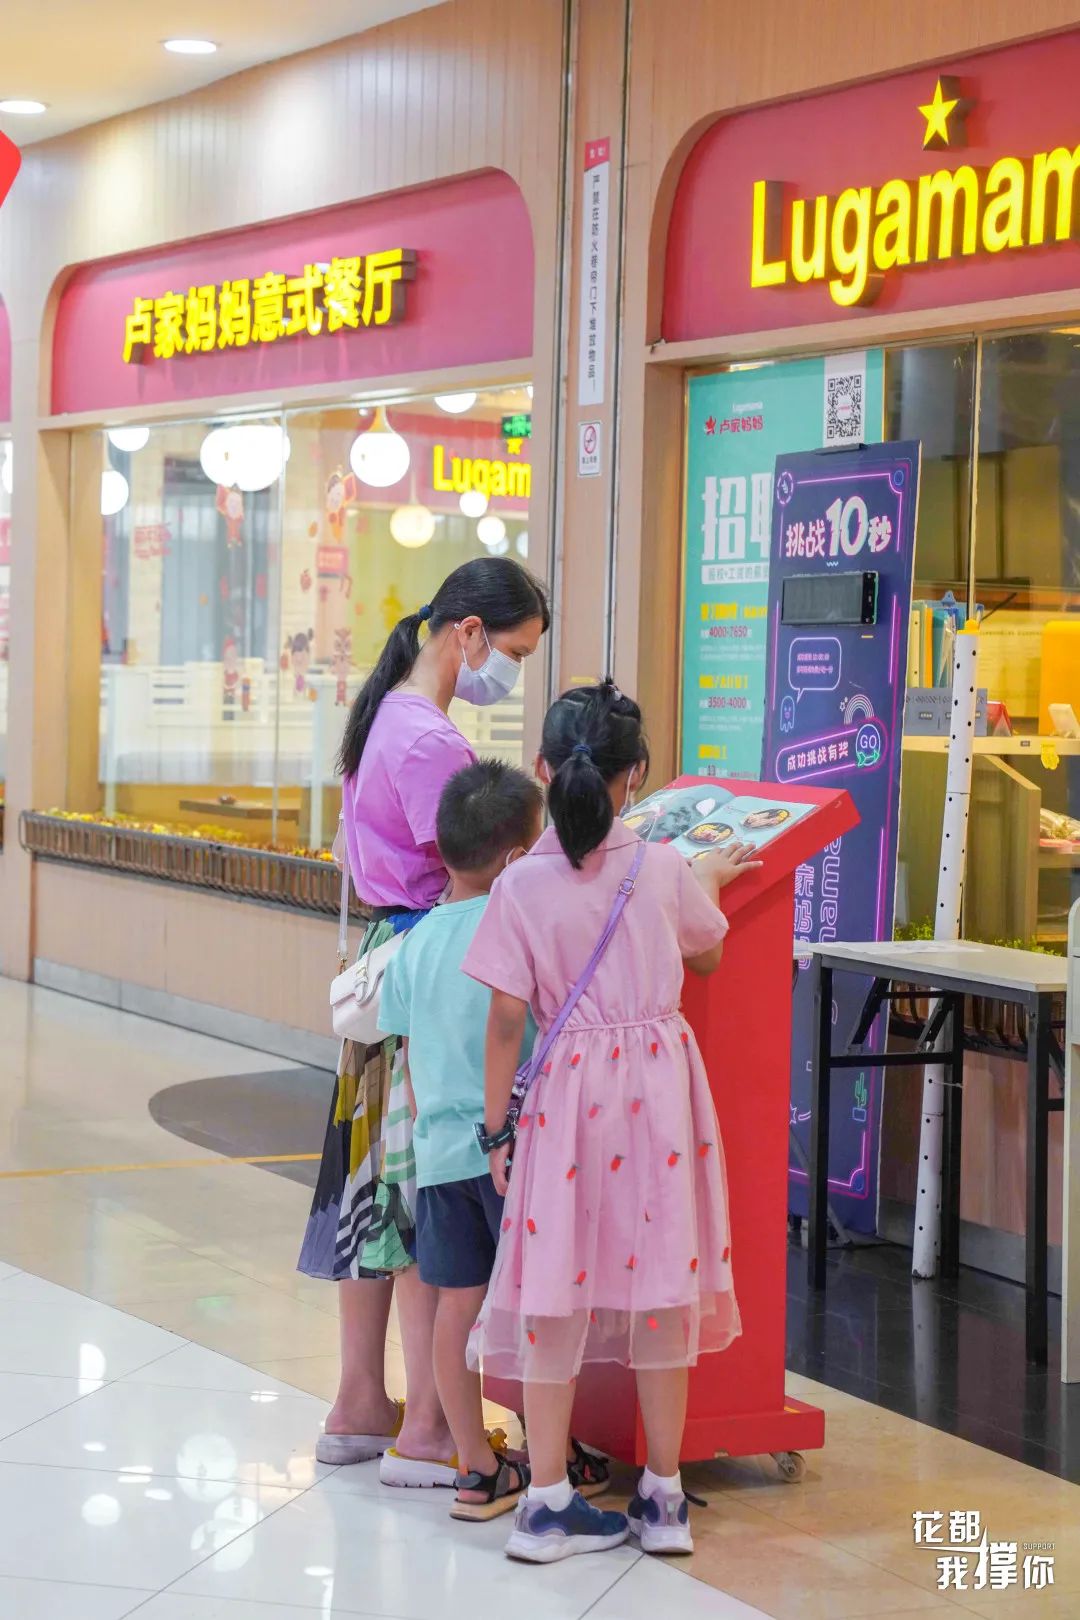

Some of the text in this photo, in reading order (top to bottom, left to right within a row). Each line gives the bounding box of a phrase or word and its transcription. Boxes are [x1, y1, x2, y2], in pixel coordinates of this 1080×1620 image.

[750, 144, 1080, 307] Lugamam
[122, 248, 404, 364] 卢家妈妈意式餐厅
[719, 415, 763, 434] 卢家妈妈
[786, 495, 892, 558] 挑战10秒
[787, 741, 849, 772] 成功挑战有奖
[859, 734, 878, 749] GO
